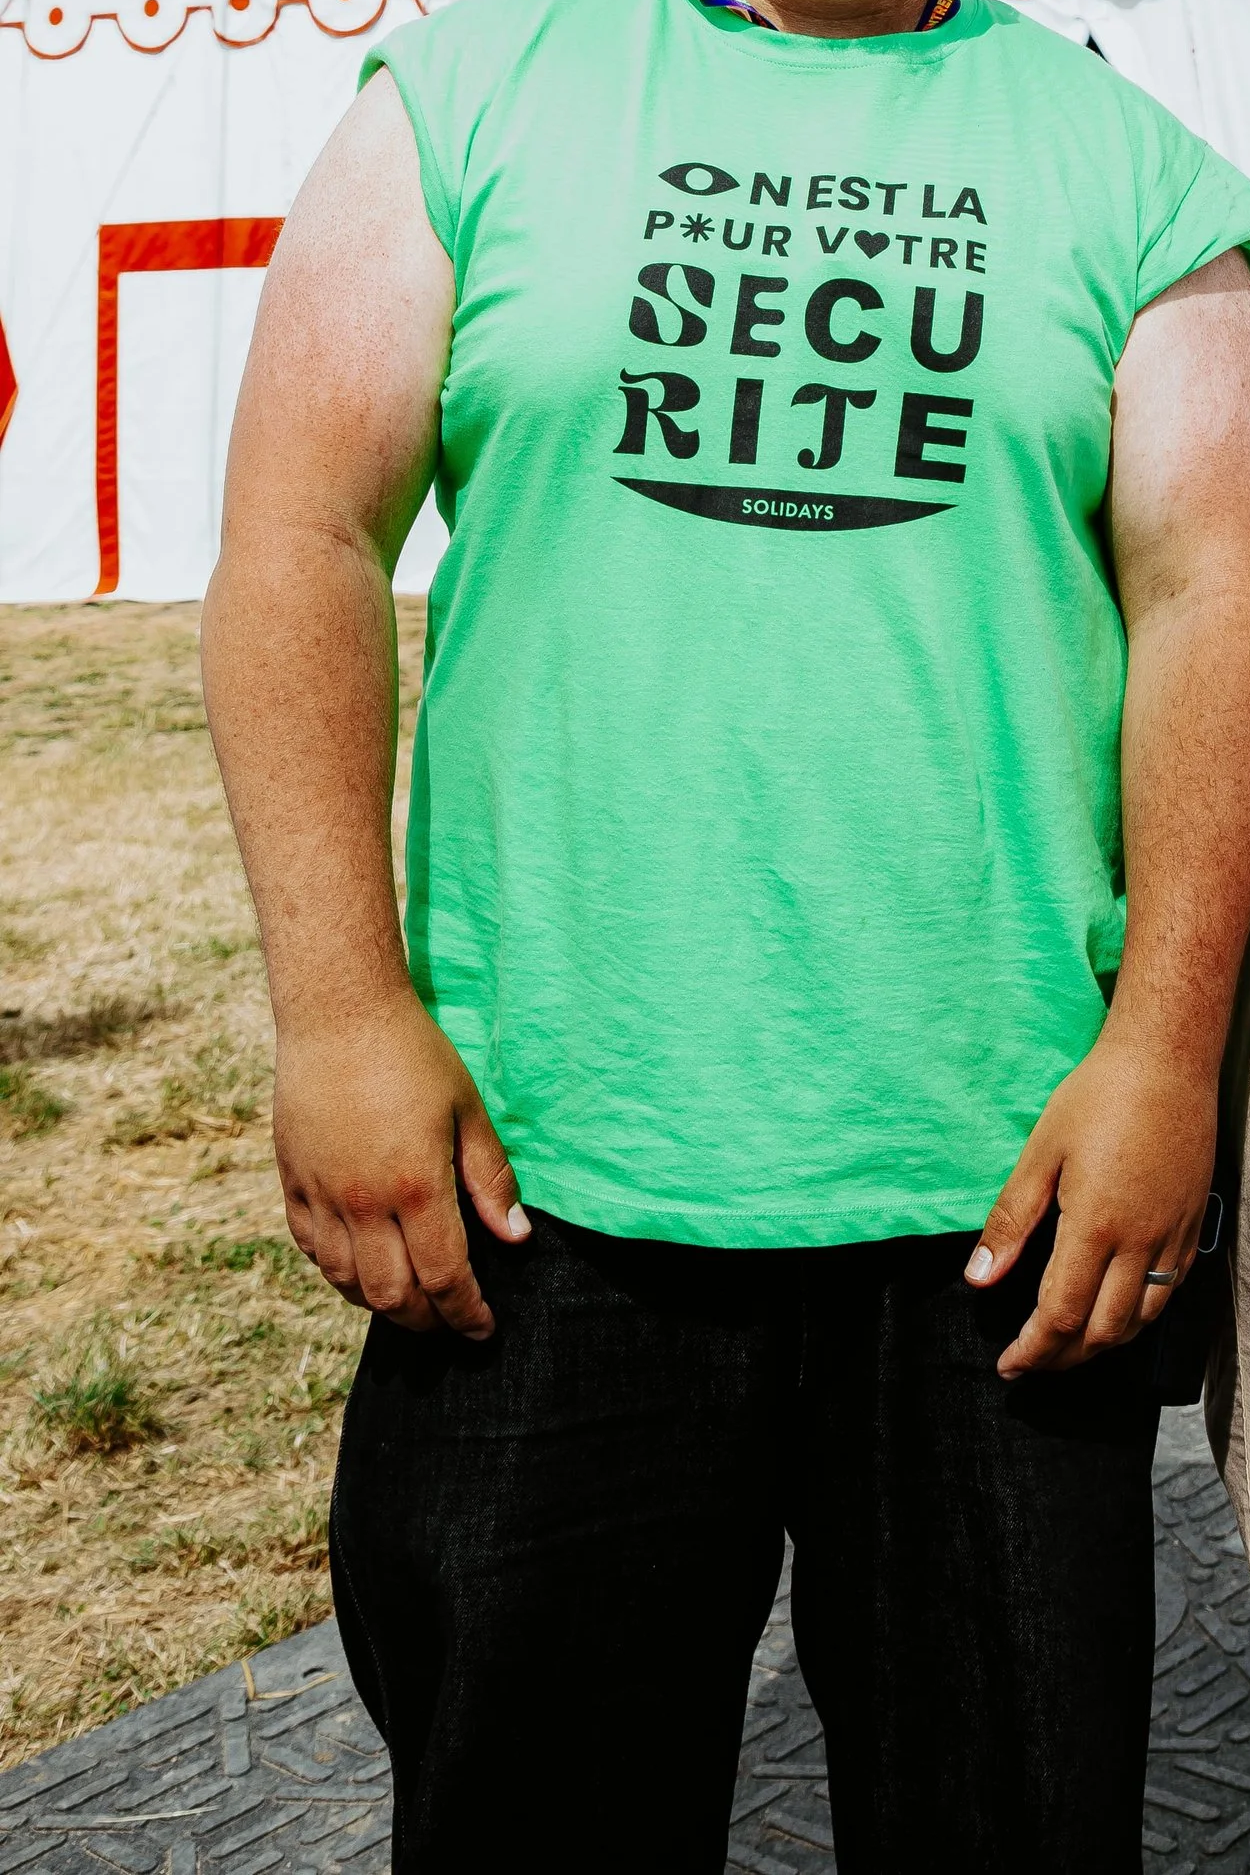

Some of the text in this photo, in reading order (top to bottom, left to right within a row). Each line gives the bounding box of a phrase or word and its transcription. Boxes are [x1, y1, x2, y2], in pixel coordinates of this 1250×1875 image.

[806, 175, 907, 216] EST
[921, 184, 988, 225] LA
[629, 263, 985, 373] SECU
[612, 367, 974, 484] RITE
[742, 499, 834, 520] SOLIDAYS
